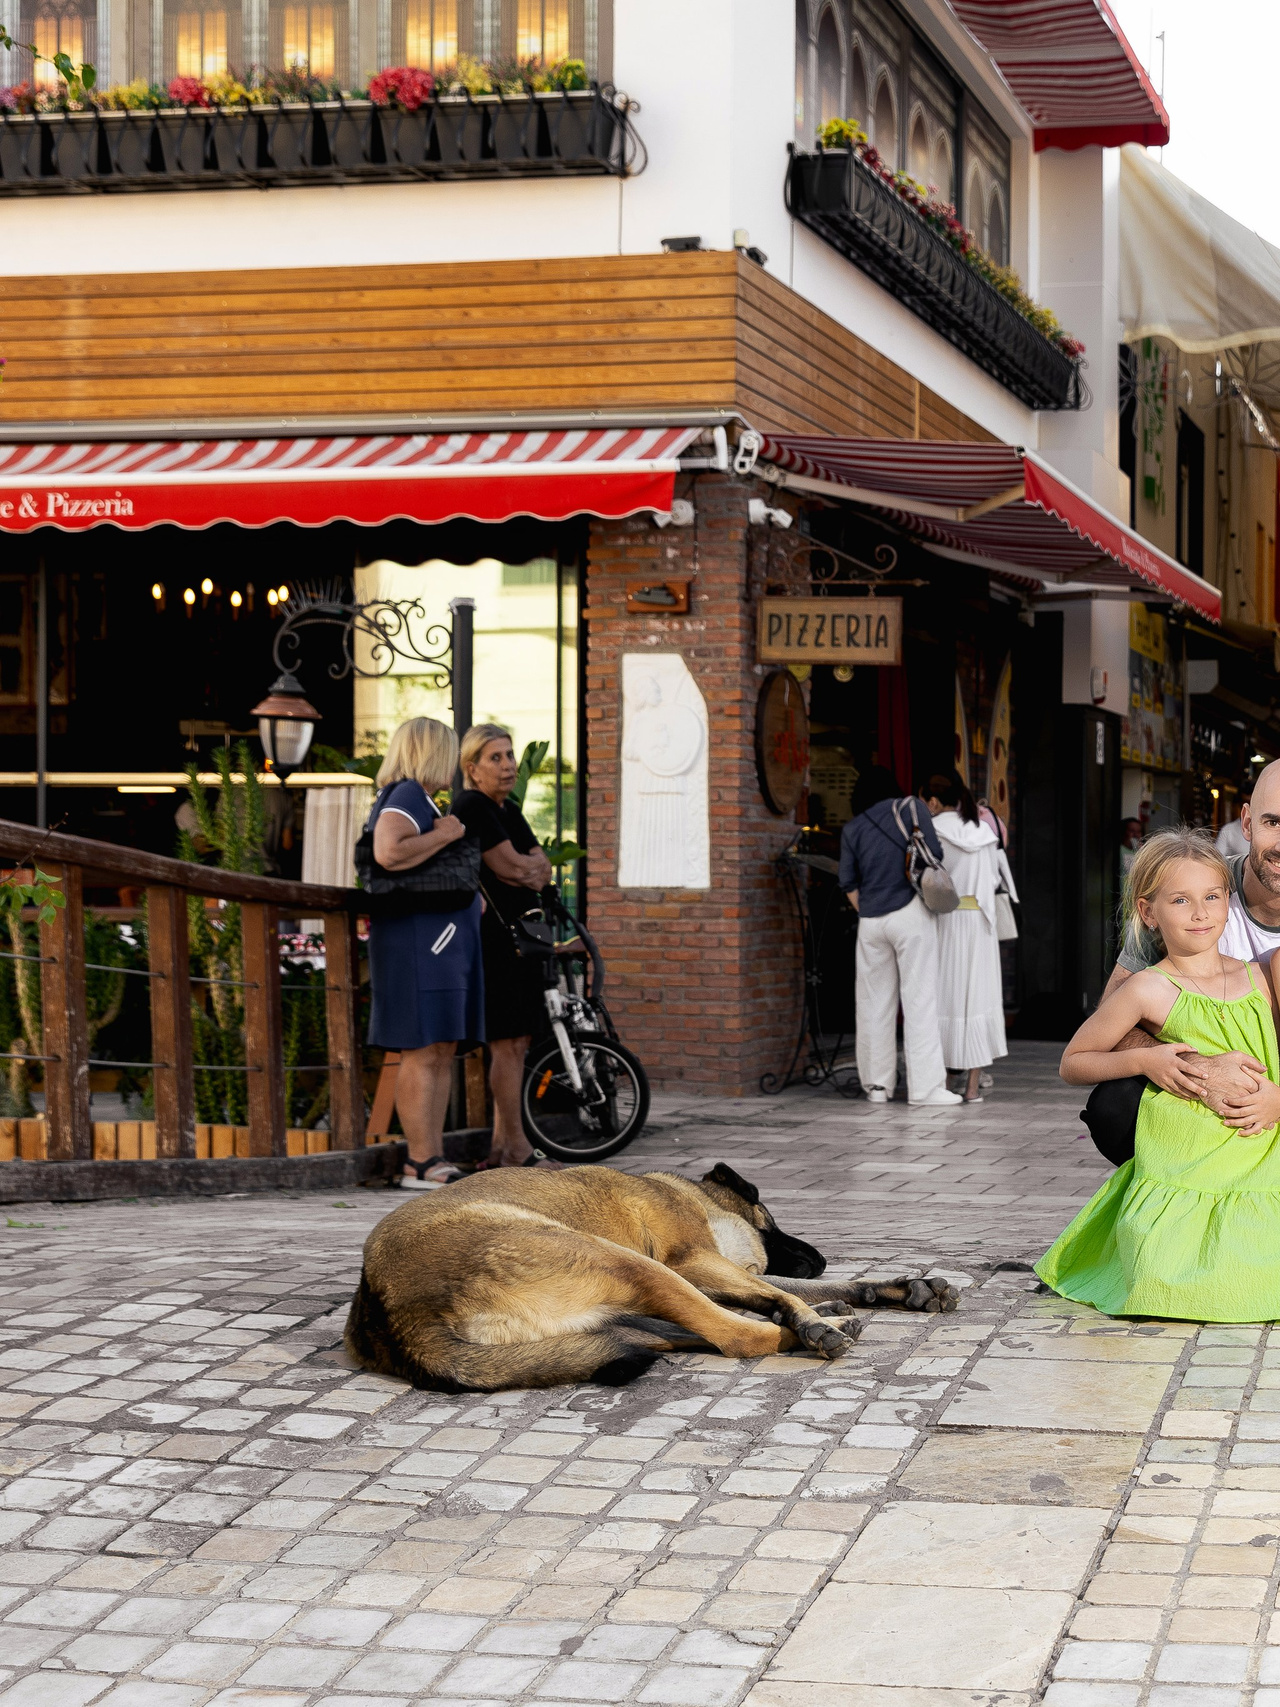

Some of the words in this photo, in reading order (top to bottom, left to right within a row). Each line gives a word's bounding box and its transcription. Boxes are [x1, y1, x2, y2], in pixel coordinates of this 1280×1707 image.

[18, 492, 40, 518] &
[47, 490, 136, 518] Pizzeria
[767, 612, 890, 649] PIZZERIA
